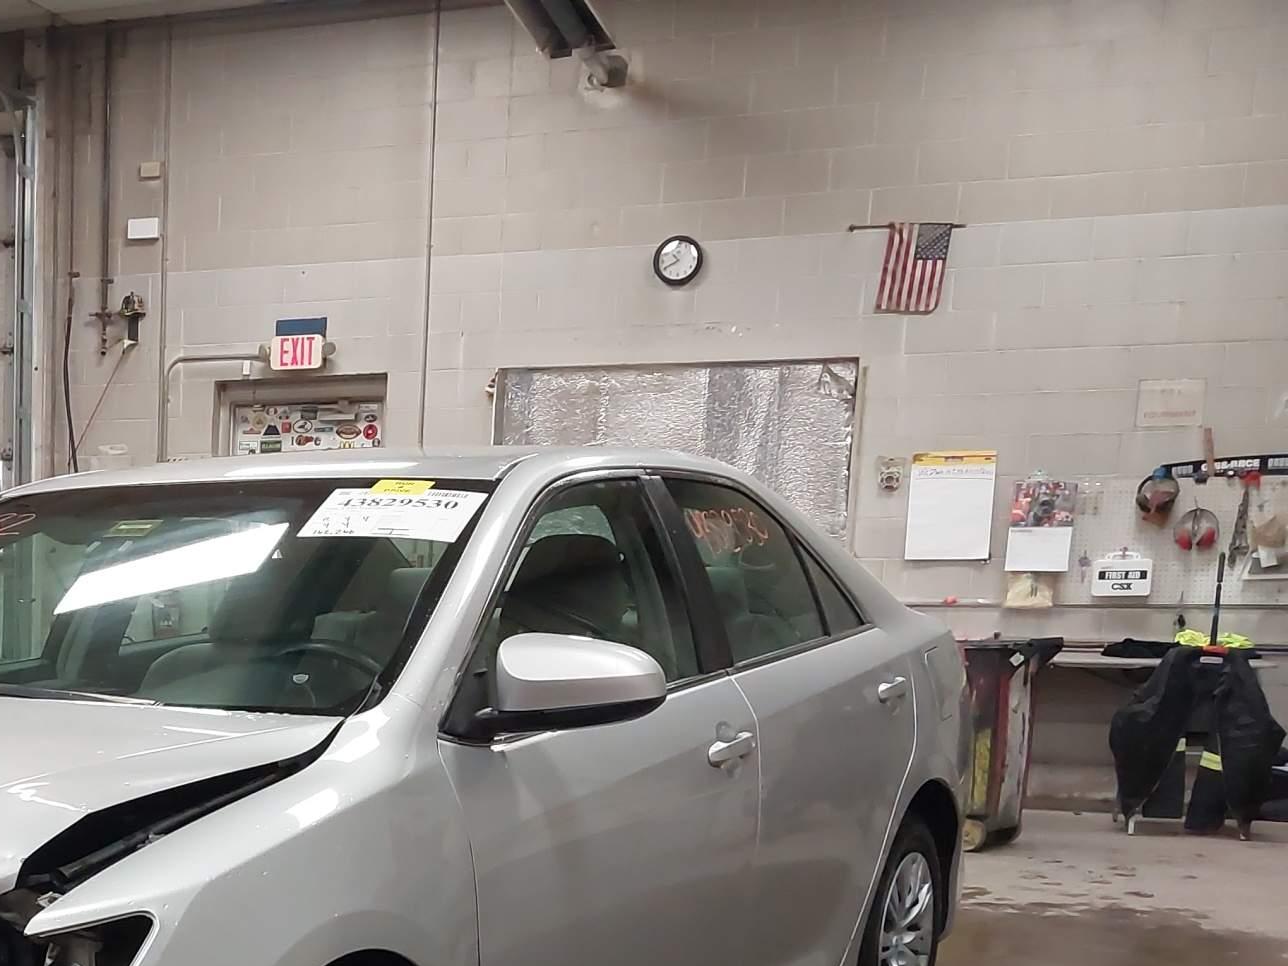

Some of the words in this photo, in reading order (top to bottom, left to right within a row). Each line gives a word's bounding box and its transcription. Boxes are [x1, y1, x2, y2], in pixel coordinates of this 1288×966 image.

[279, 337, 315, 366] EXIT
[338, 497, 459, 510] 43829530
[1105, 571, 1126, 579] FIRST
[1128, 571, 1141, 579] AID
